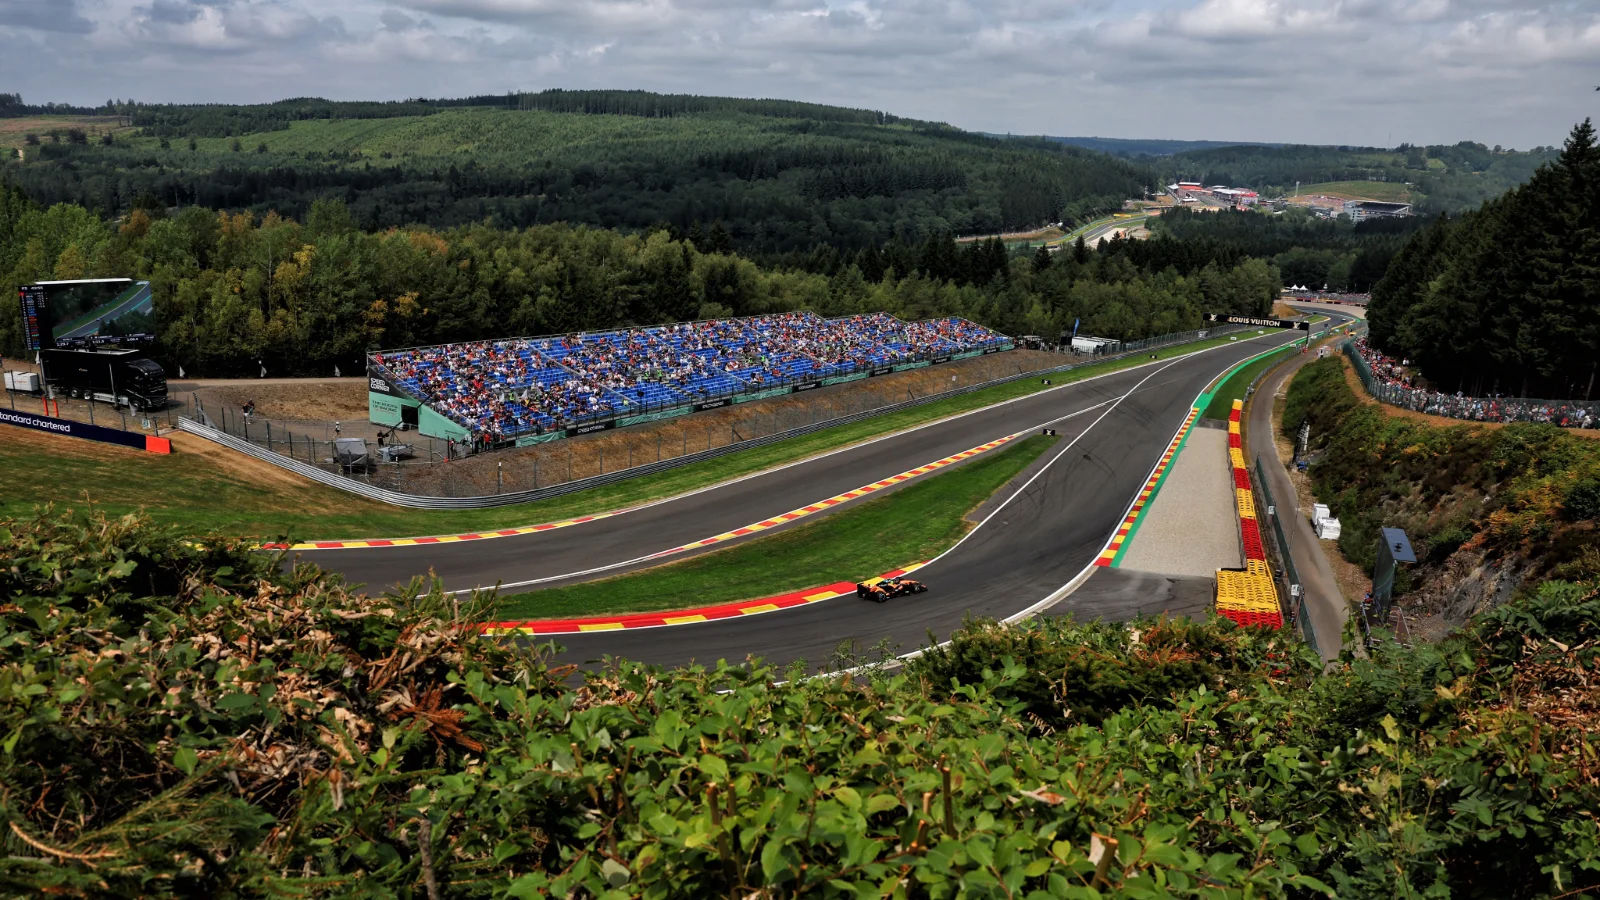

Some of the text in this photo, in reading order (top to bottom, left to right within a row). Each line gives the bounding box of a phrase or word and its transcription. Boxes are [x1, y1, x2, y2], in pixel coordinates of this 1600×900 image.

[1229, 316, 1280, 327] LOUIS VUITTON
[0, 412, 71, 432] tandard chartered
